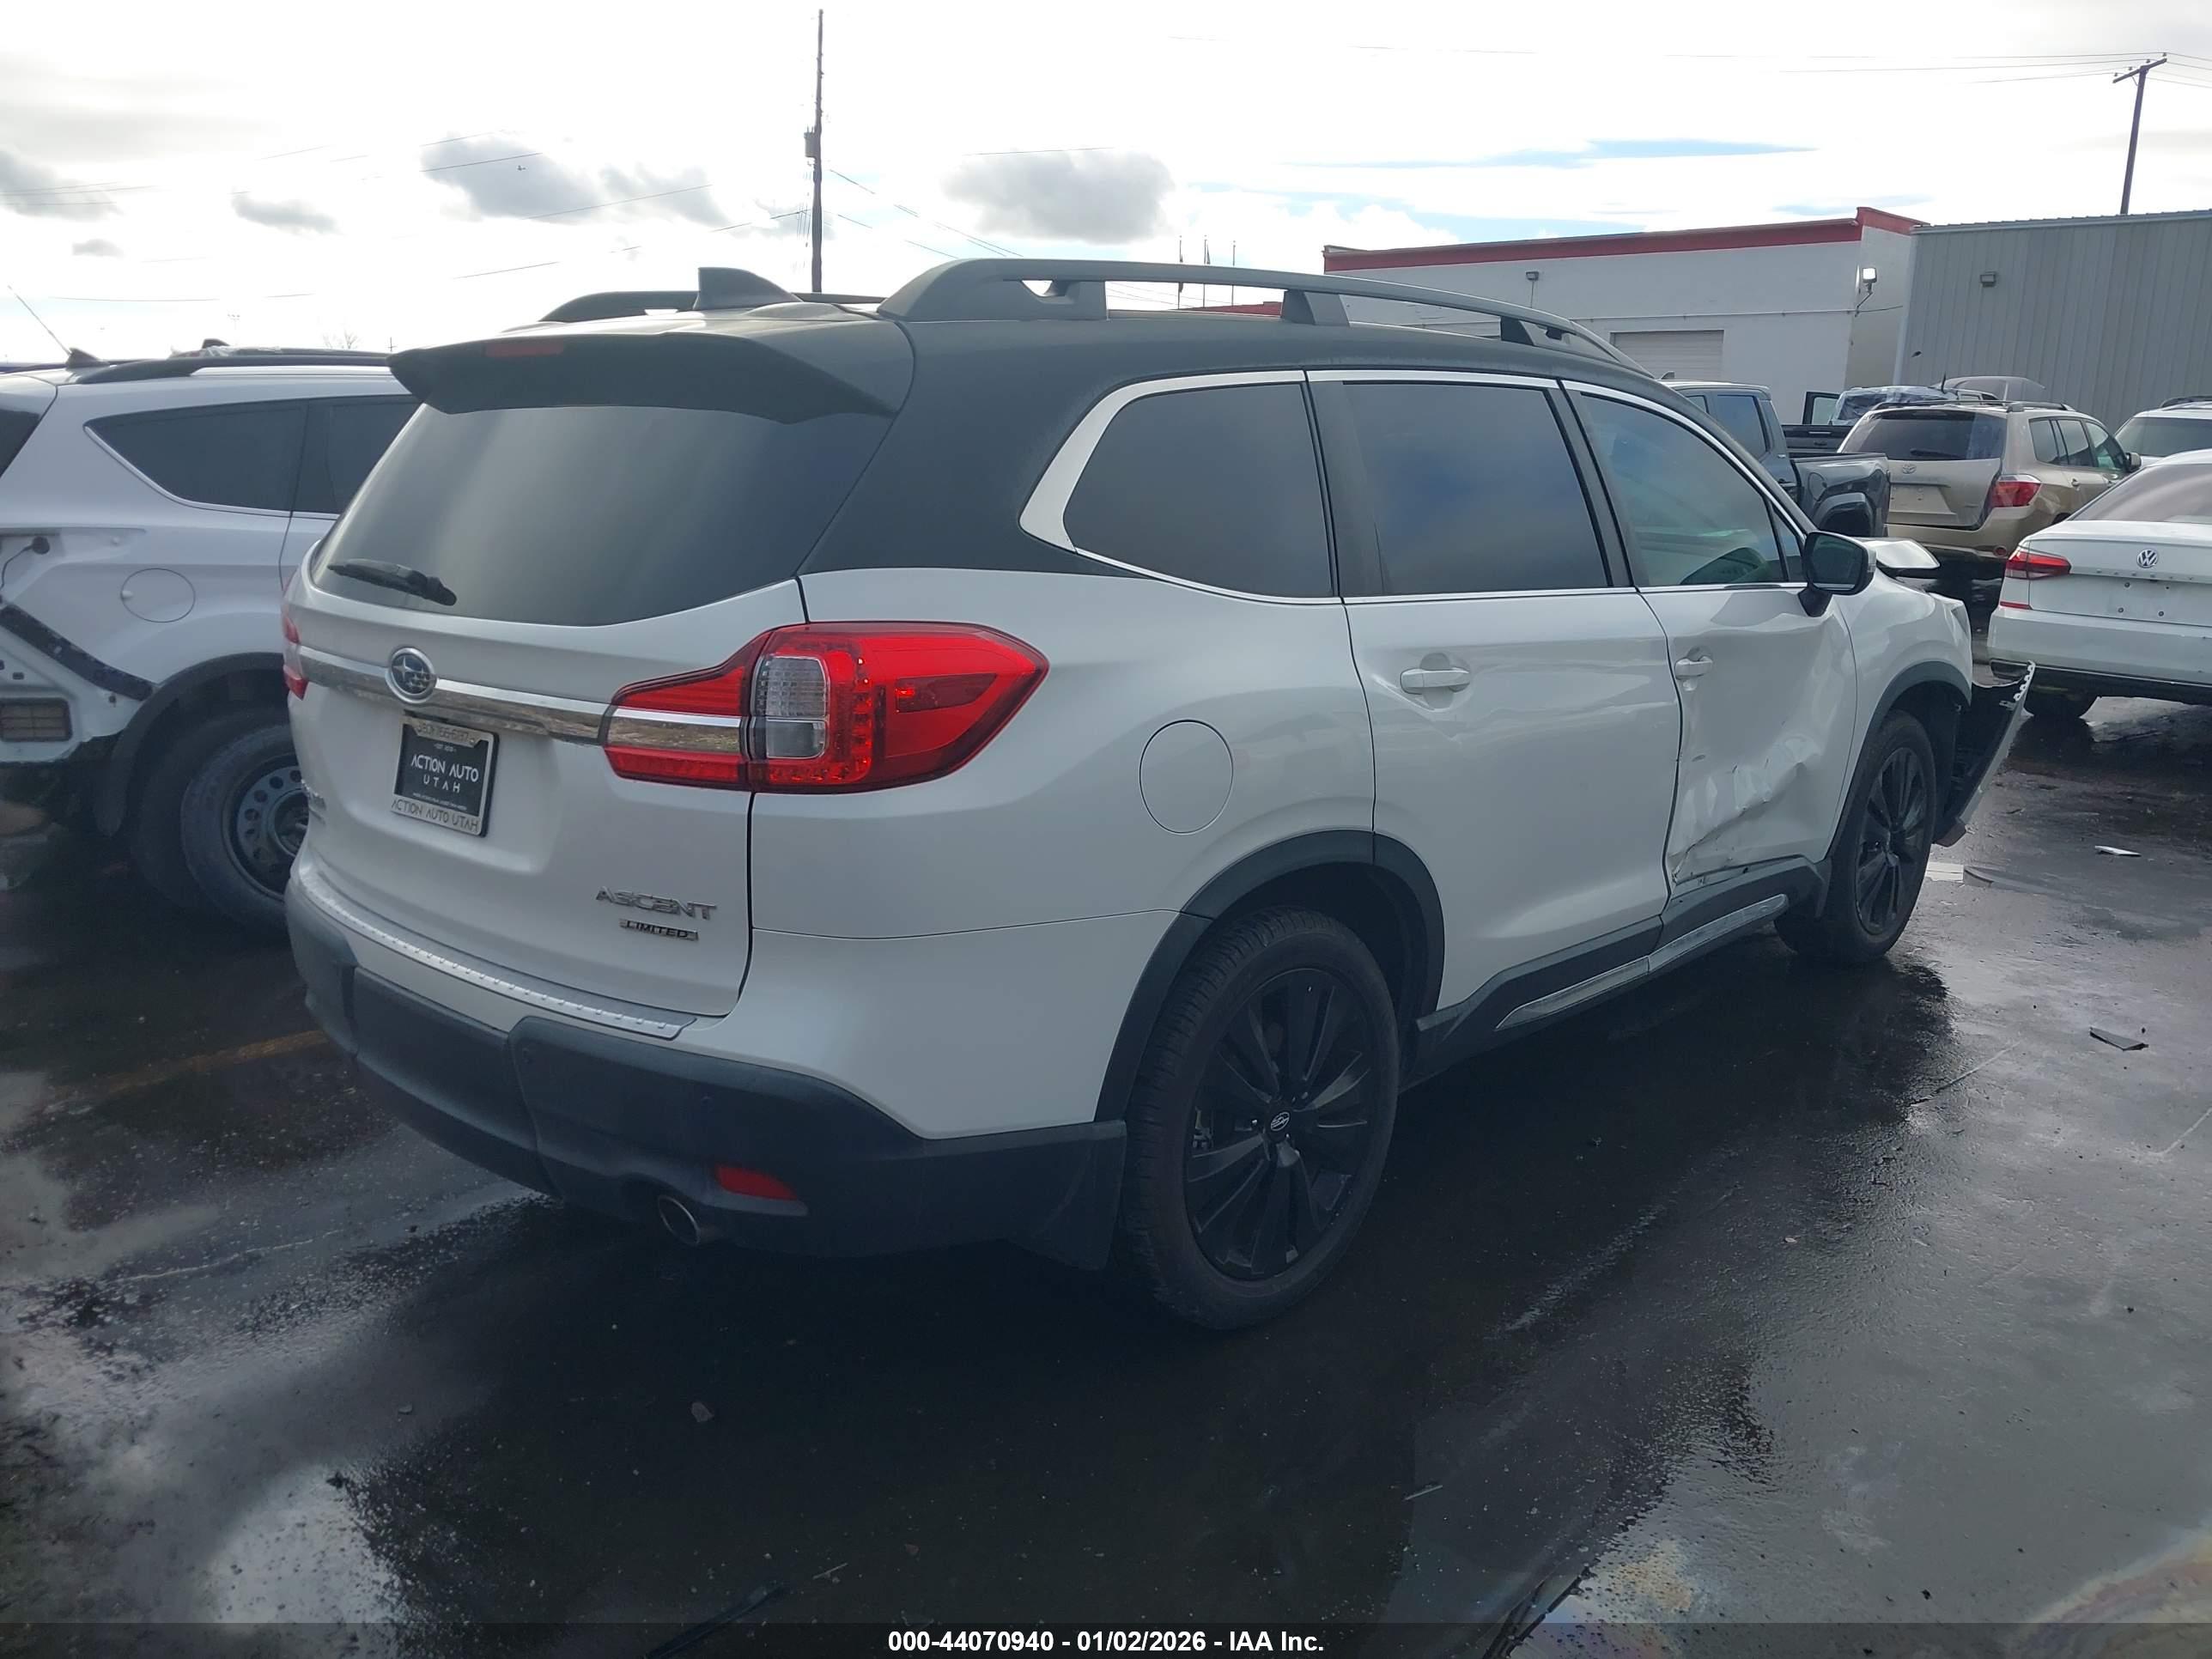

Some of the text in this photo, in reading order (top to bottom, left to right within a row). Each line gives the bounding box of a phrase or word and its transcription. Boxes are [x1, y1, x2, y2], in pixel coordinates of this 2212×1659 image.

[410, 754, 479, 782] ACTION AUTO
[422, 774, 461, 793] UTAH
[425, 809, 449, 823] AUTO
[452, 811, 479, 833] UTAH
[595, 885, 717, 921] ASCENT
[626, 919, 689, 939] LIMITED
